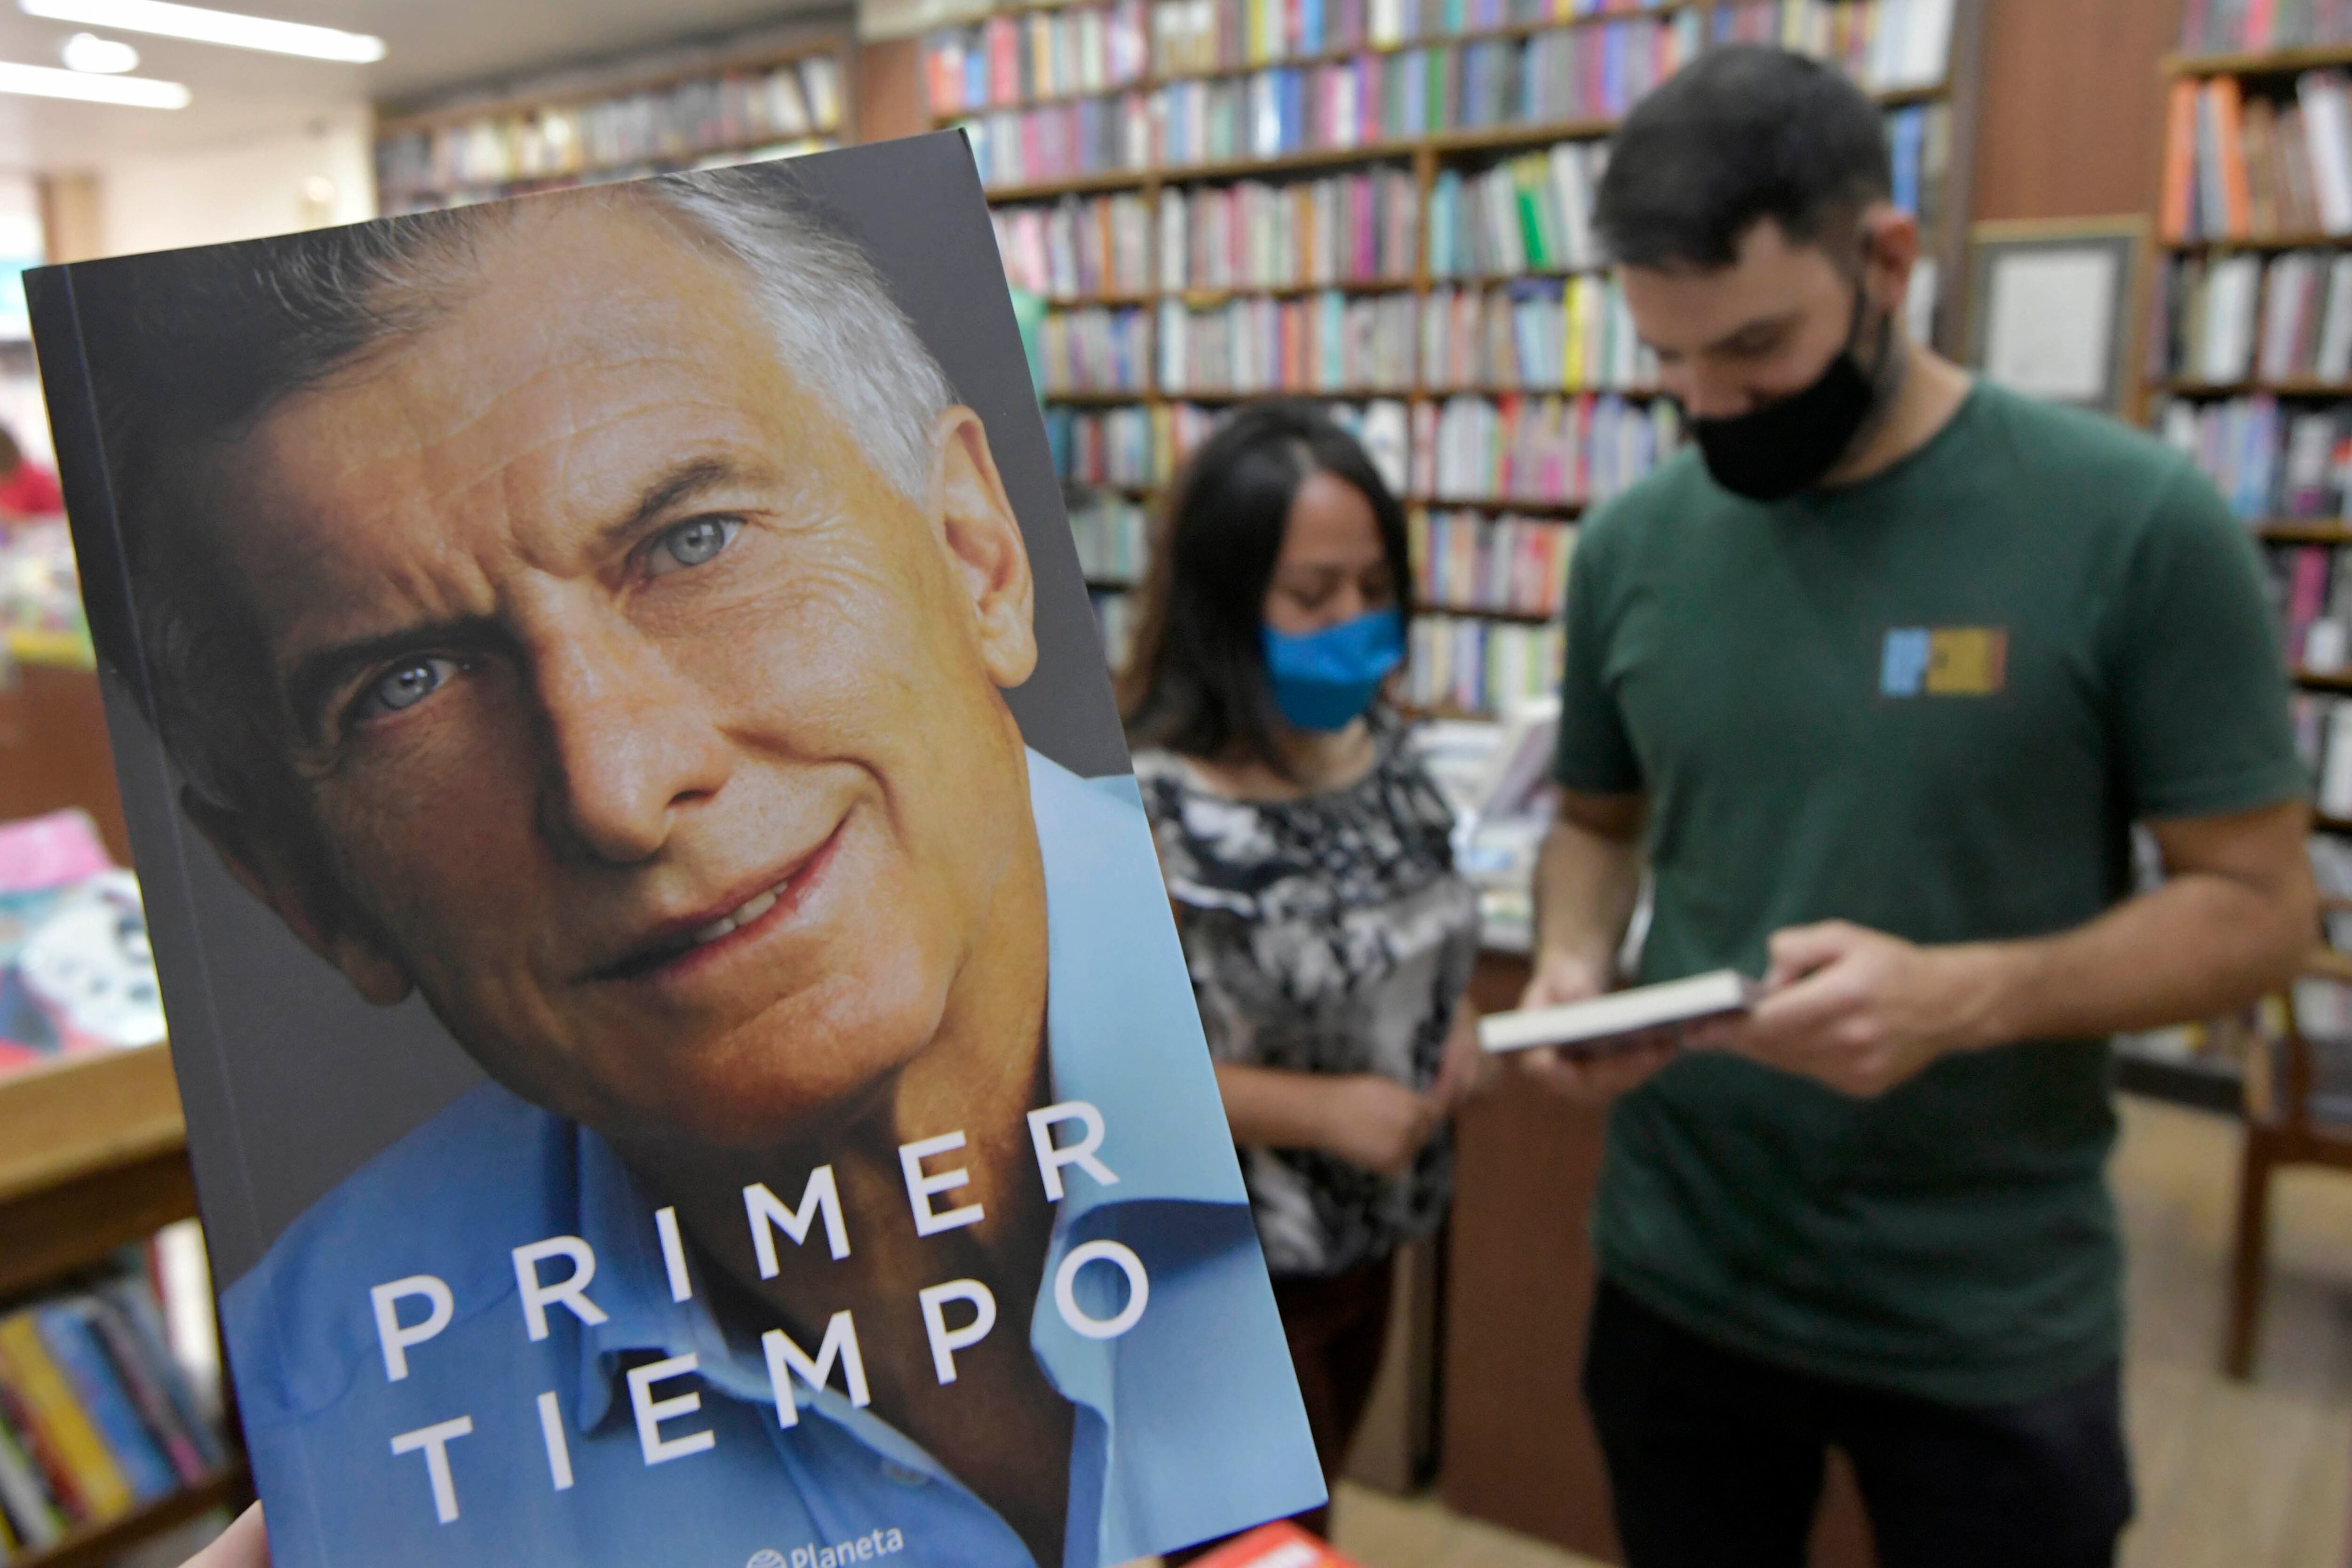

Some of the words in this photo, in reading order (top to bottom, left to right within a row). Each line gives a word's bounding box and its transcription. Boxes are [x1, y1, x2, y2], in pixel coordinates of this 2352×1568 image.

[371, 1100, 1119, 1382] PRIMER
[391, 1239, 1149, 1524] TIEMPO
[791, 1528, 904, 1568] Planeta
